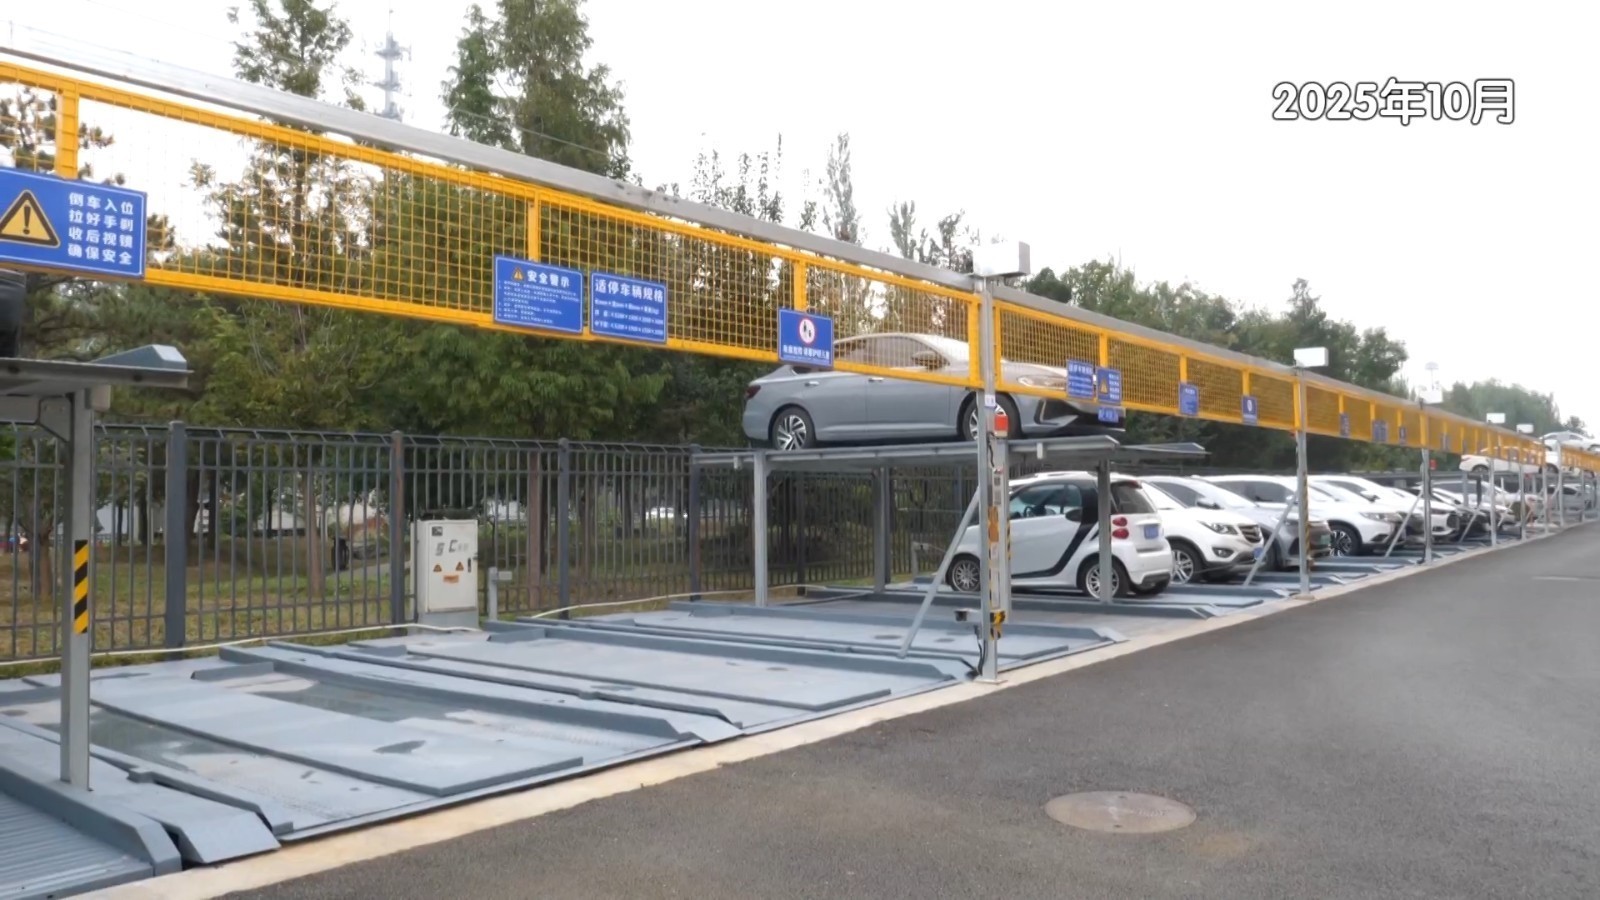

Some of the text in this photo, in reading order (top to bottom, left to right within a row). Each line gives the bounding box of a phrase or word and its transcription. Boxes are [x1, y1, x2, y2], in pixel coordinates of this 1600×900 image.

[69, 192, 134, 215] 倒车入位
[68, 209, 134, 232] 拉好手刹
[68, 227, 133, 249] 收后视镜
[67, 243, 132, 265] 确保安全
[527, 270, 570, 287] 安全警示
[595, 280, 663, 303] 适停车辆规格
